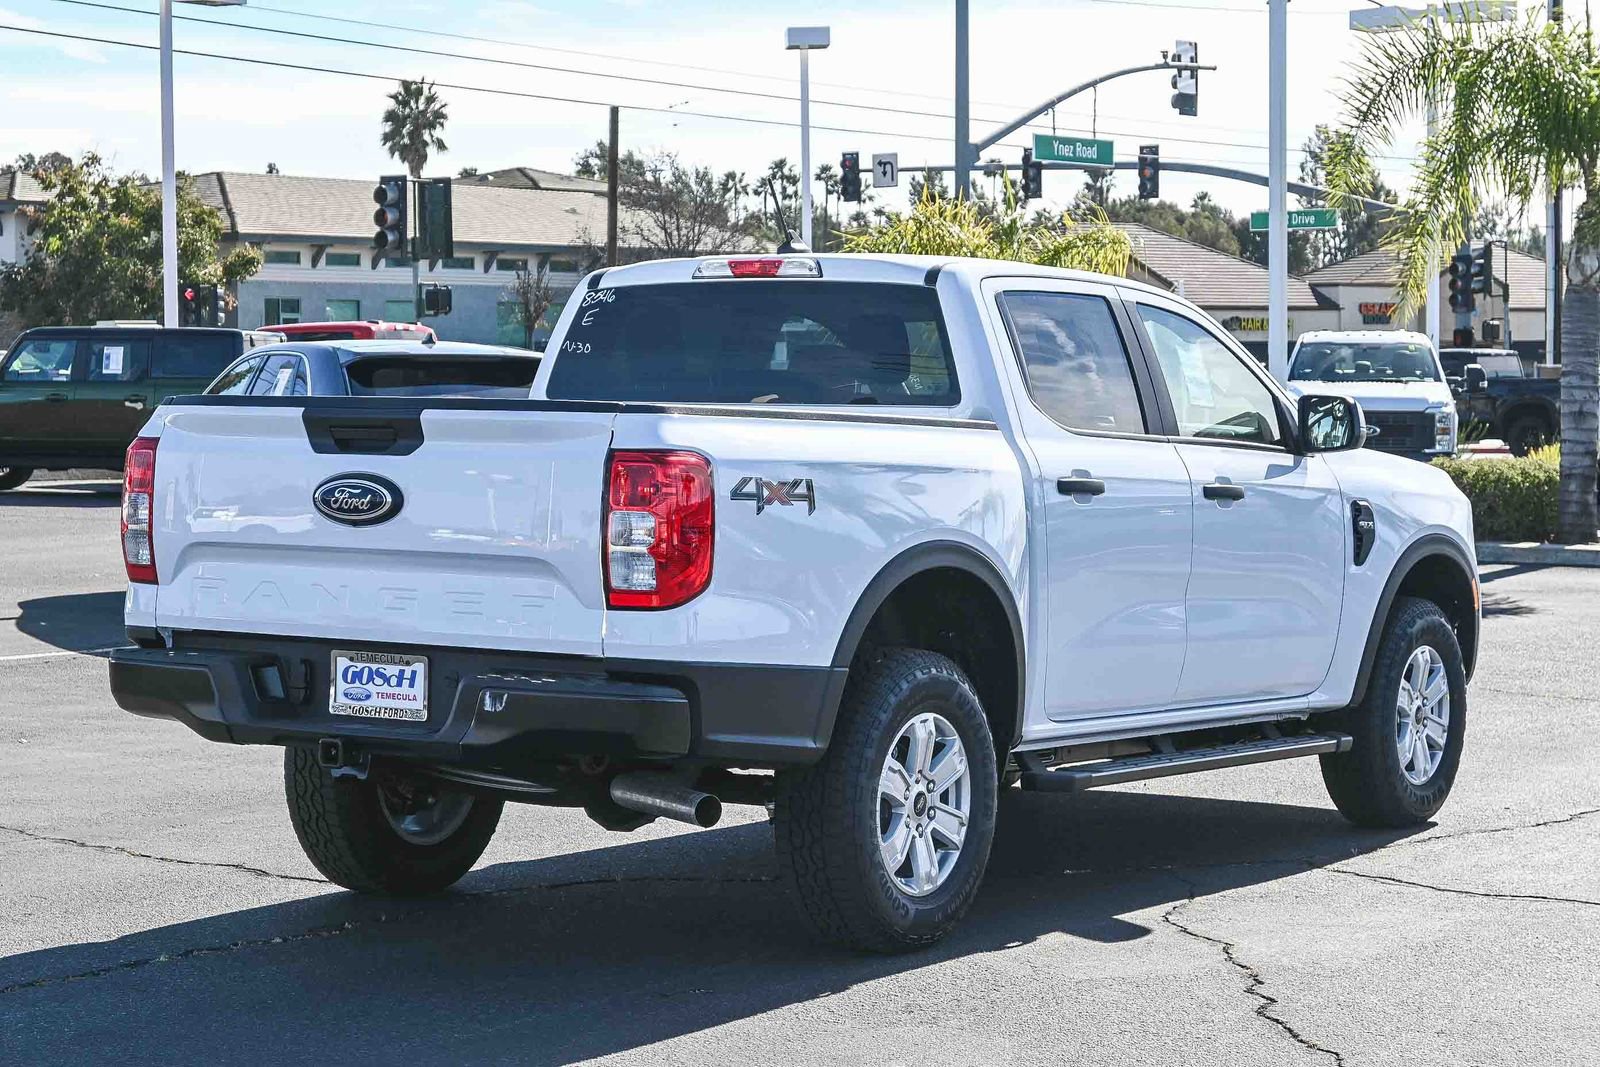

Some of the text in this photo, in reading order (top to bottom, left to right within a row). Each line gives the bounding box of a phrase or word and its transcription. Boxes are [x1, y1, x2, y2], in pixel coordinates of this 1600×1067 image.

[1052, 140, 1098, 159] Ynez Road
[1292, 213, 1316, 225] Drive
[581, 308, 600, 326] E
[1241, 318, 1262, 330] HAIR
[330, 487, 372, 510] Ford
[191, 575, 556, 636] RANGER
[354, 652, 405, 664] TEMECULA
[375, 691, 418, 702] TEMECULA
[382, 707, 406, 719] FORD
